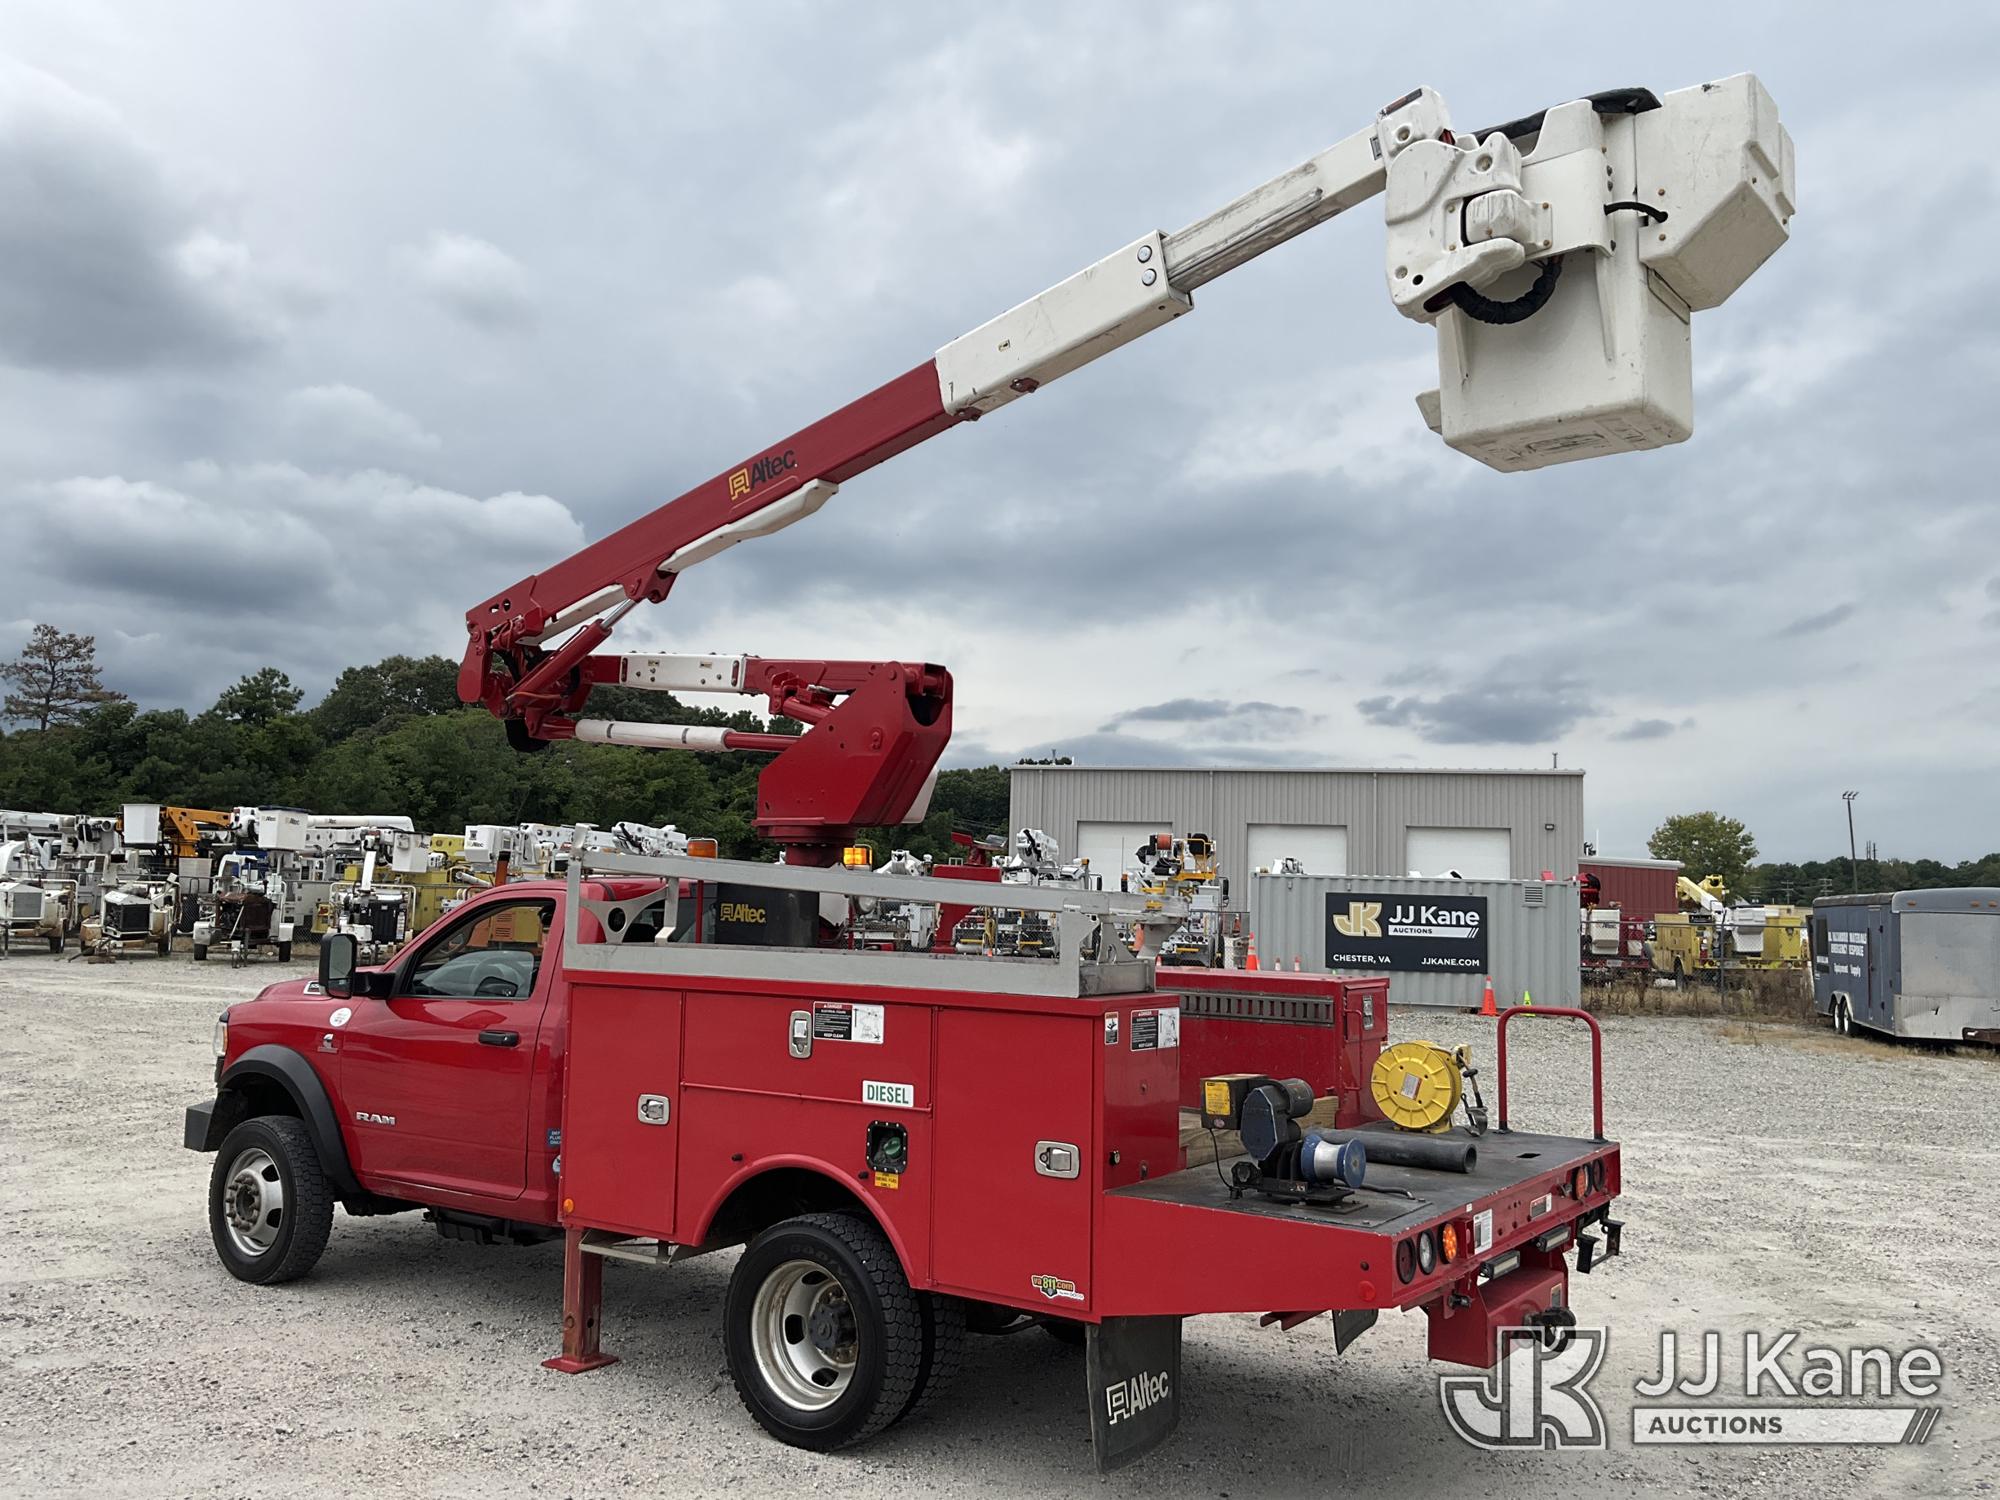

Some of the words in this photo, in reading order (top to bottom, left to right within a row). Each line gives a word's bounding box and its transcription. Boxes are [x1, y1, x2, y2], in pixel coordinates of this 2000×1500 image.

[751, 449, 796, 490] Altec
[733, 903, 766, 924] Altec
[1388, 905, 1415, 925] JJ
[1420, 905, 1480, 926] Kane
[1392, 927, 1433, 935] AUCTIONS
[1332, 953, 1377, 964] CHESTER,
[1378, 955, 1391, 964] VA
[1421, 957, 1480, 967] JJKANE.COM
[867, 1084, 909, 1105] DIESEL
[356, 1111, 396, 1126] RAM
[1130, 1370, 1169, 1416] Altec
